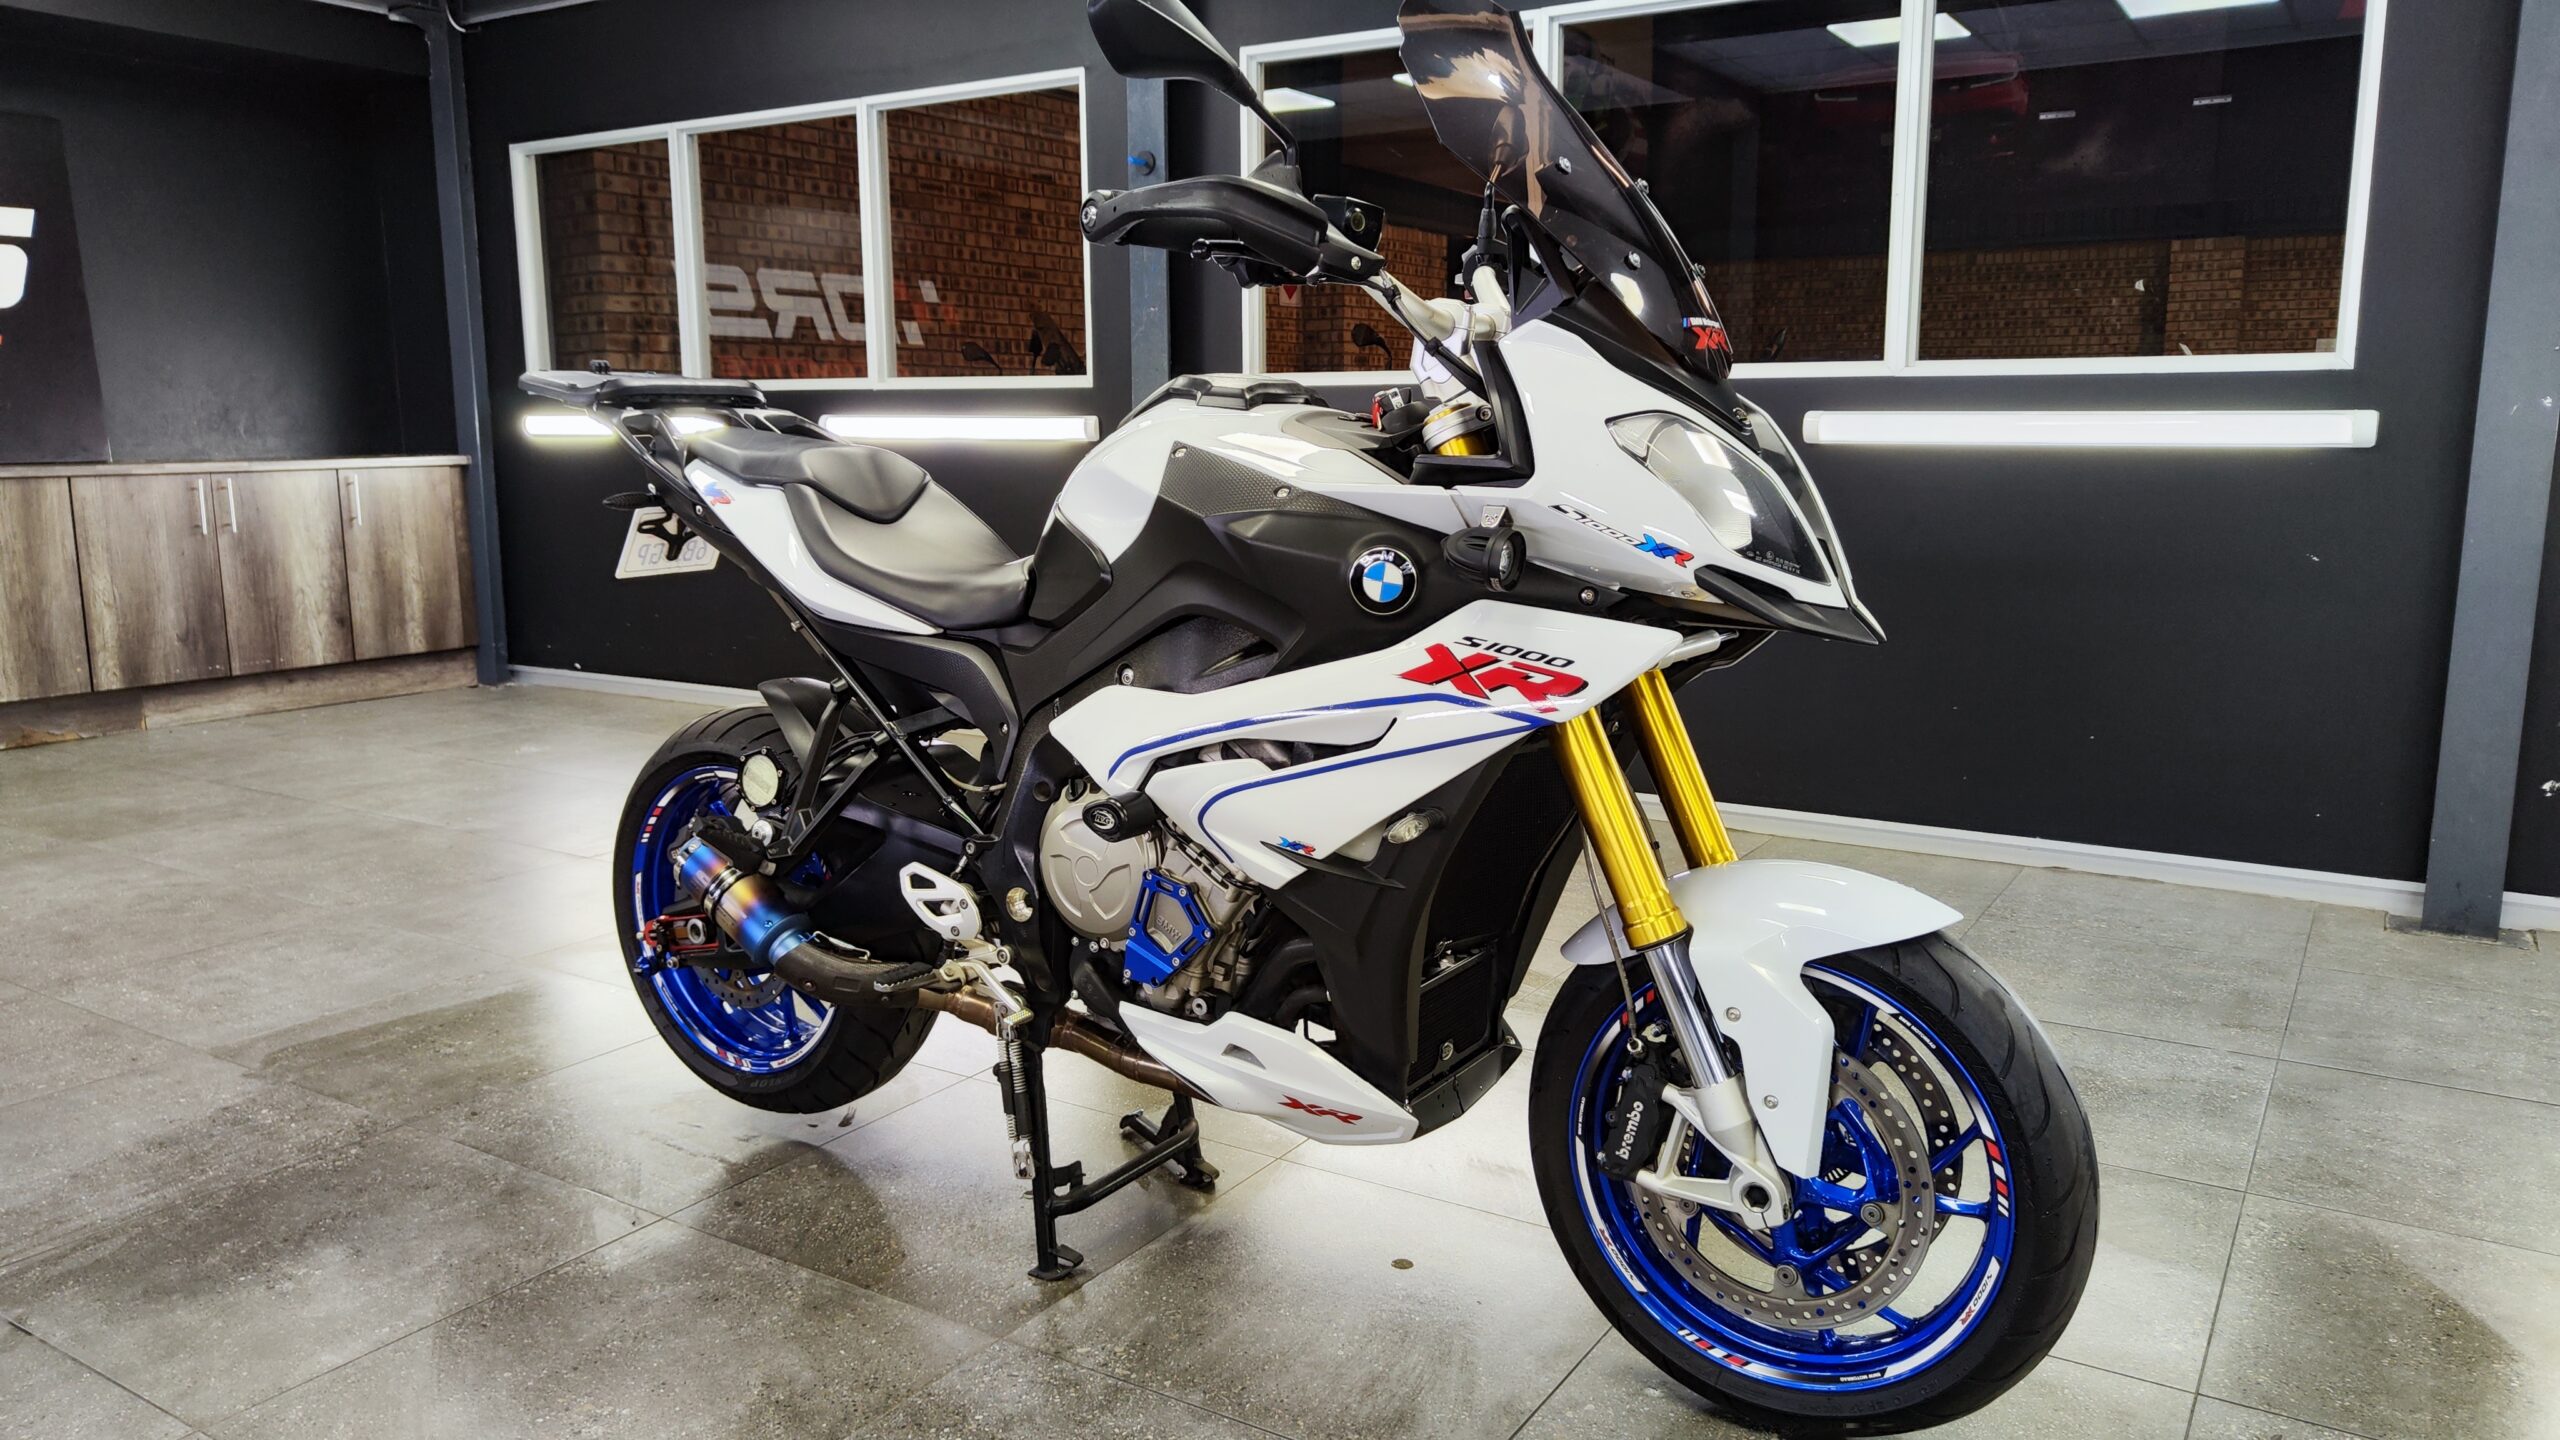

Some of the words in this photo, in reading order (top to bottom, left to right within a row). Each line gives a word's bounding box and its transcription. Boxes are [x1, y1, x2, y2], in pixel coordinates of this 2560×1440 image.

[1692, 327, 1729, 351] XR
[1360, 550, 1414, 576] BMW
[1454, 636, 1576, 668] S1000
[1394, 643, 1589, 713] XR
[1278, 835, 1317, 857] XR
[1156, 915, 1183, 941] BMW
[1277, 1093, 1364, 1126] XR
[1615, 1101, 1644, 1160] brembo
[1973, 1273, 1993, 1308] S1000
